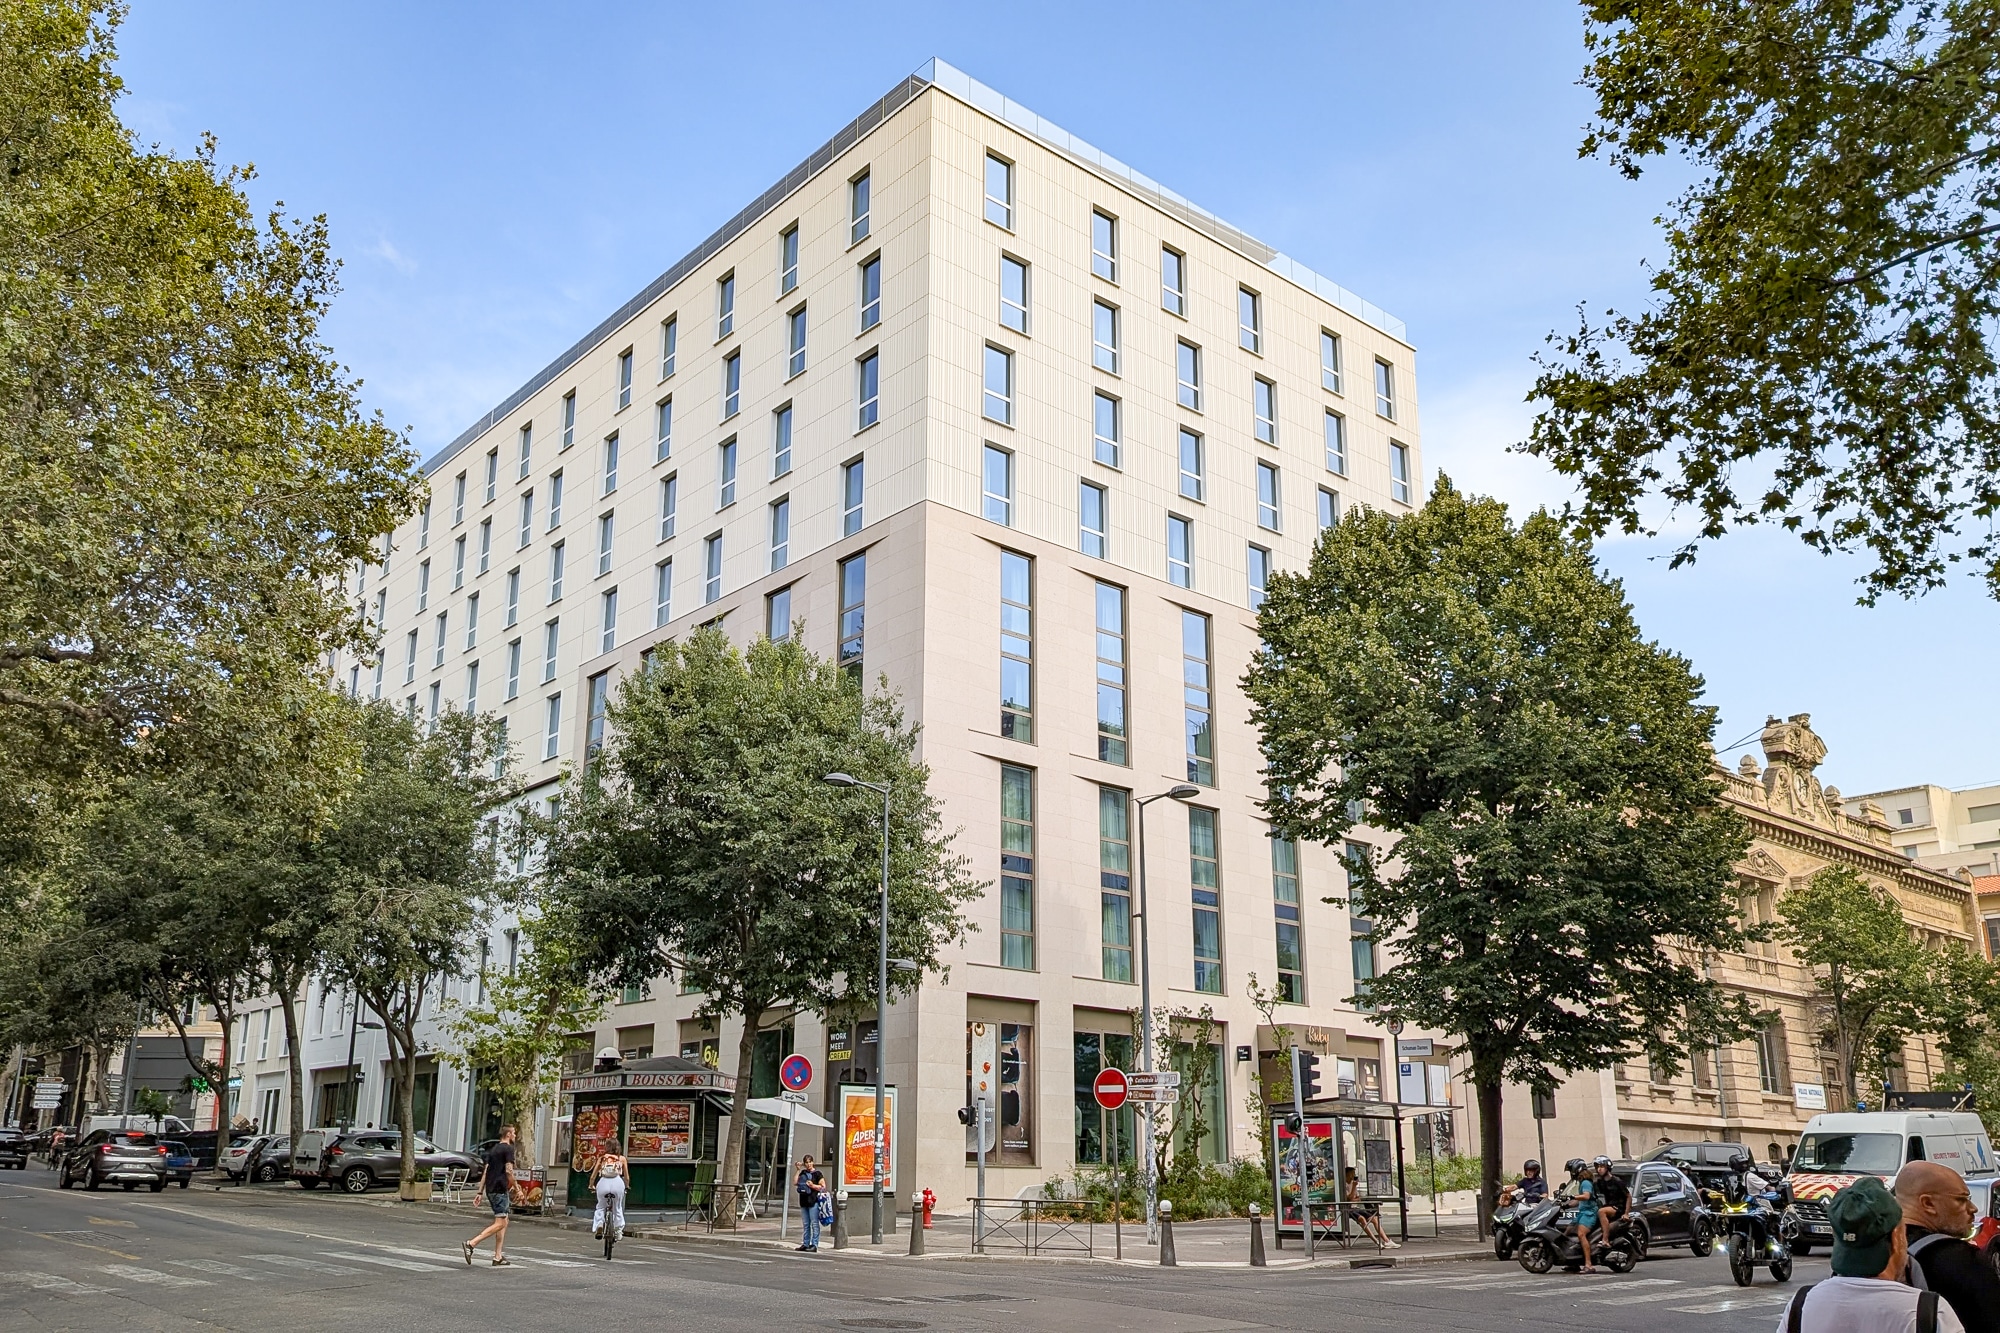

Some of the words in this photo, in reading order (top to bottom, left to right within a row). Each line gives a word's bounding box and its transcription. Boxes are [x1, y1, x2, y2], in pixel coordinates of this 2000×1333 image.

[830, 1033, 847, 1041] WORK
[1308, 1025, 1330, 1055] Ruby
[830, 1042, 844, 1050] MEET
[830, 1051, 850, 1060] CREATE
[631, 1074, 707, 1087] BOISSOS
[852, 1129, 875, 1145] APER
